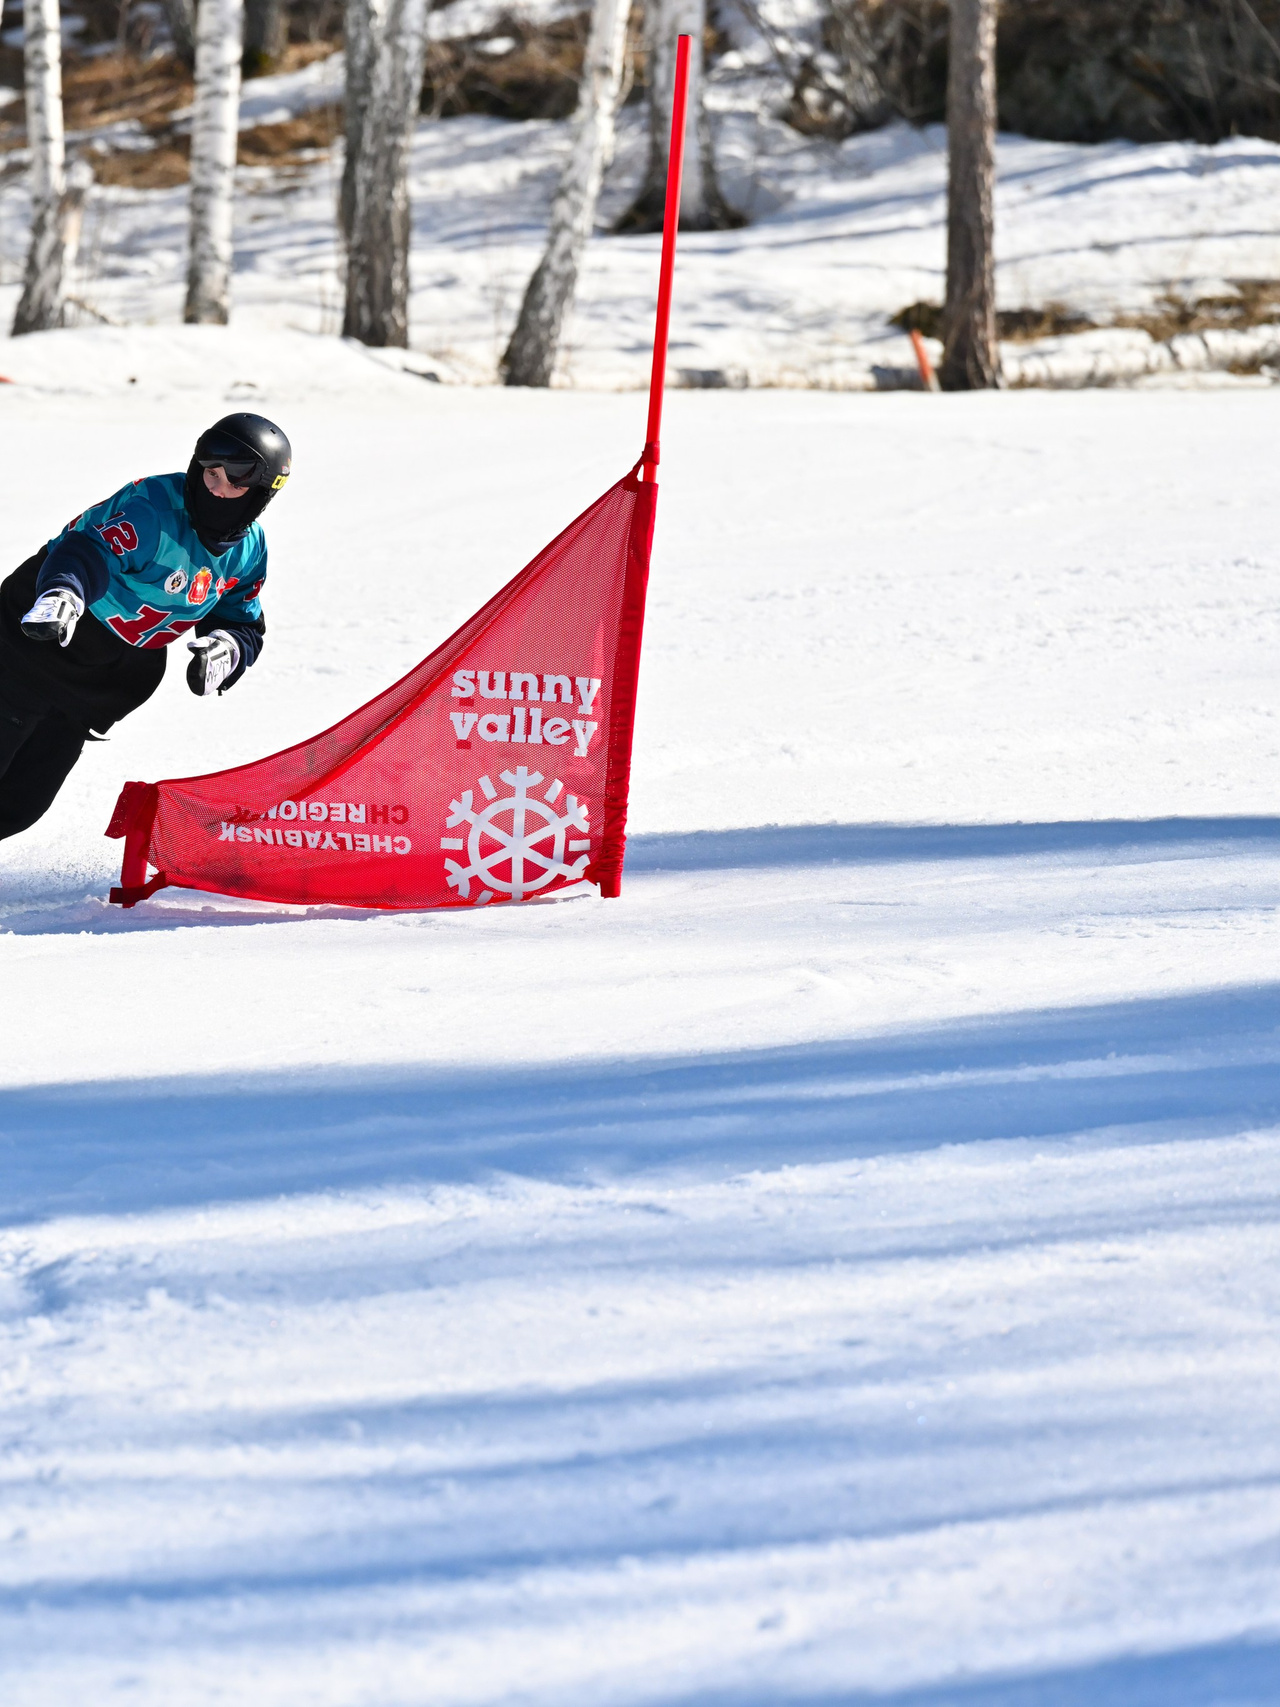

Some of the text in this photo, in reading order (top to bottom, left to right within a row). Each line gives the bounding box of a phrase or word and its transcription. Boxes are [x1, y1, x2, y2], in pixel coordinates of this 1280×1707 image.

[451, 669, 602, 715] sunny
[449, 706, 598, 757] valley
[218, 821, 412, 855] CHELYABINSK
